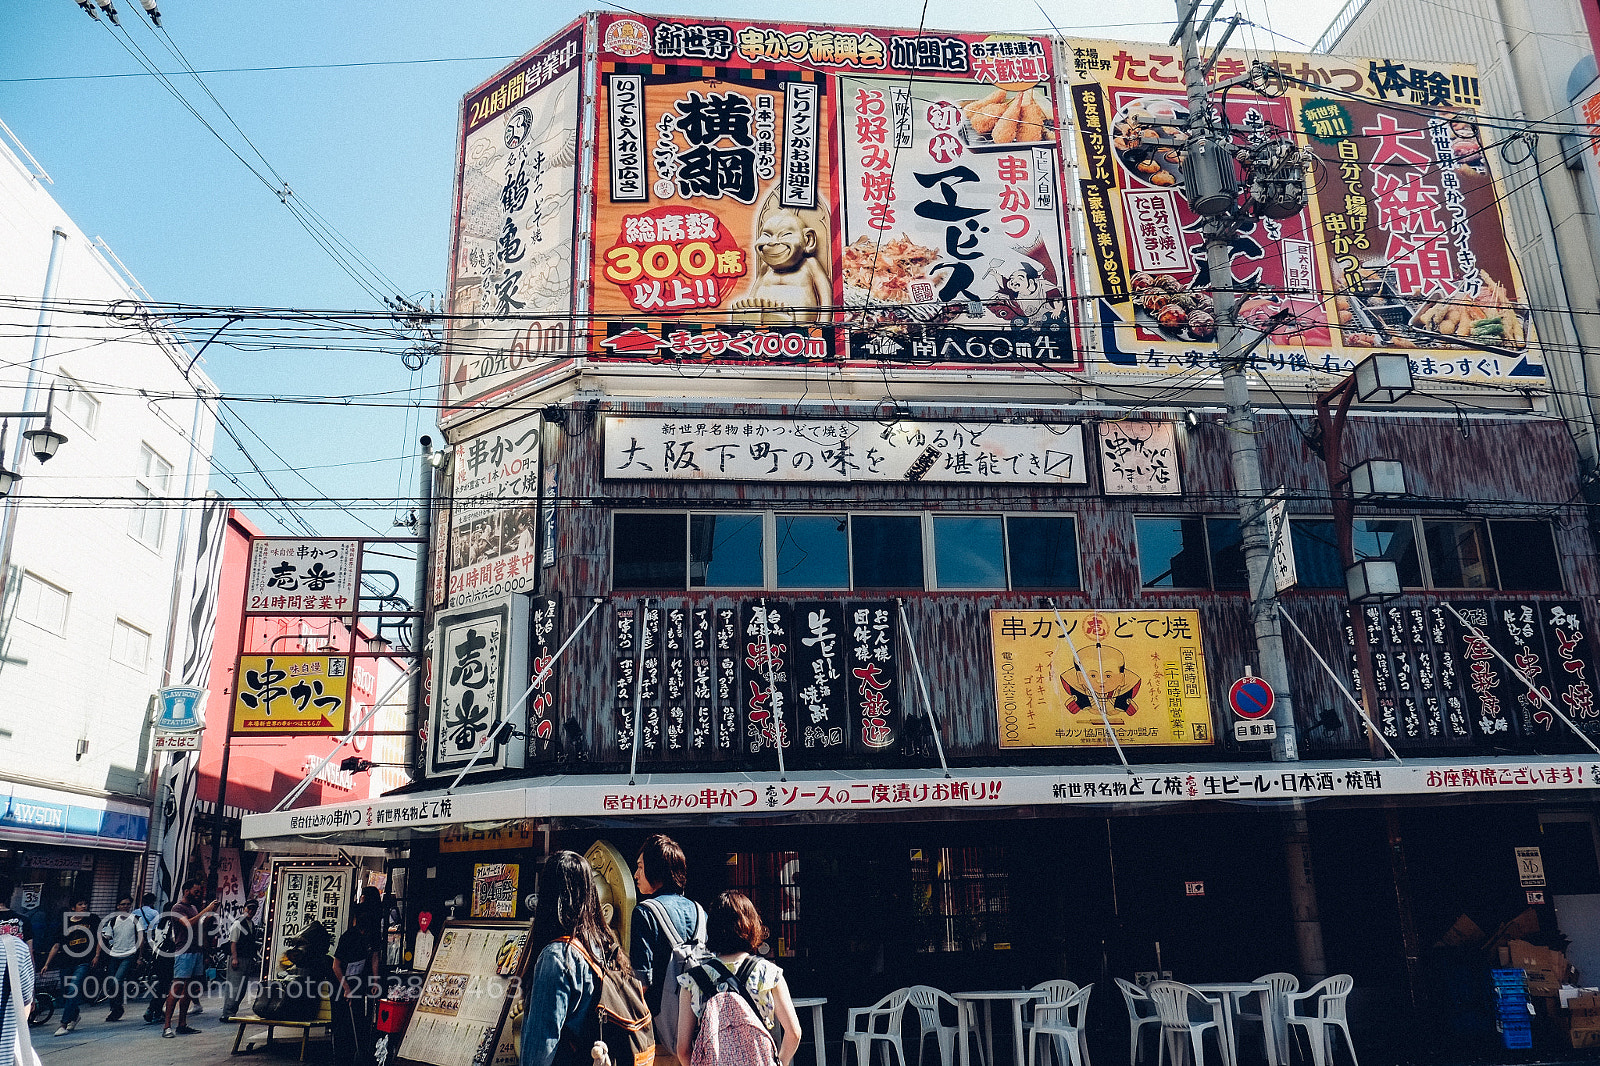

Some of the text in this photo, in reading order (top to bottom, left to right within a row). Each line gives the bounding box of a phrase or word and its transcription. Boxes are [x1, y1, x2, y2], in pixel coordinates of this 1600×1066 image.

[655, 23, 733, 59] 新世界
[738, 28, 886, 67] 串かつ振興会
[890, 37, 967, 71] 加盟店
[971, 42, 1043, 57] お子様連れ
[1074, 48, 1098, 59] 本場
[1074, 58, 1111, 70] 新世界
[469, 39, 578, 128] 24時間営業中
[893, 89, 911, 145] 大阪名物
[928, 102, 963, 162] 初代
[1305, 107, 1340, 121] 新世界
[616, 79, 638, 193] いつでも入れる広さ
[655, 114, 676, 181] よこづな
[676, 93, 757, 204] 横綱
[757, 96, 775, 179] 日本一の串かつ
[788, 88, 811, 201] ビリケンがお出迎え
[1082, 91, 1110, 185] お友達、カップル、
[855, 89, 897, 230] お好み焼き
[998, 155, 1030, 239] 串かつ
[1337, 140, 1370, 250] 自分で揚げる
[1362, 113, 1457, 297] 大統領
[1429, 118, 1481, 298] 新世界串かつバイキング
[494, 160, 530, 322] 鶴亀家
[623, 213, 718, 243] 総席数
[913, 166, 991, 301] エビス
[1151, 196, 1178, 262] 自分で焼く
[605, 243, 745, 282] 300席
[633, 279, 716, 308] 以上!!
[669, 329, 827, 358] まっすぐ100m
[912, 336, 1062, 360] 南へ60m先
[661, 422, 848, 438] 新世界名物串かつ・どて焼き
[456, 444, 467, 485] 味自慢
[467, 428, 539, 477] 串かつ
[617, 437, 884, 477] 大阪下町の味を
[1112, 459, 1171, 484] うまい店
[270, 545, 338, 560] 味自慢 串かつ
[450, 551, 534, 594] 24時間営業中
[267, 561, 336, 591] 壱番
[251, 595, 348, 610] 24時間営業中
[695, 609, 708, 630] イカ
[1519, 605, 1535, 637] 屋台
[618, 618, 634, 648] 串かつ
[668, 627, 679, 649] もち
[801, 608, 841, 680] 生ビール
[853, 608, 873, 662] 団体様
[872, 609, 892, 662] お一人様
[1001, 615, 1078, 641] 串カツ
[1114, 616, 1193, 640] どて焼
[1504, 609, 1525, 646] 仕込み
[240, 658, 342, 716] 串かつ
[289, 662, 322, 674] 味自慢
[694, 666, 710, 699] どて焼
[812, 658, 832, 697] 日本酒
[1035, 663, 1047, 705] オオキニ
[1182, 648, 1198, 696] 営業時間
[1556, 628, 1600, 719] どて焼
[164, 691, 199, 700] LAWSON
[446, 629, 489, 750] 壱番
[617, 678, 629, 699] キス
[641, 678, 654, 699] チーズ
[799, 684, 830, 724] 焼酎
[852, 662, 895, 748] 大歓迎
[1024, 675, 1037, 730] ゴヒイキニ
[1165, 662, 1186, 740] 二十四時間営業中
[1514, 645, 1554, 732] 串かつ
[161, 718, 195, 727] STATION
[698, 706, 710, 735] にんにく
[1237, 722, 1276, 737] 自動車
[603, 788, 758, 811] 屋台仕込みの串かつ
[1052, 776, 1183, 799] 新世界名物どて焼
[4, 803, 63, 827] LAWSON
[290, 809, 362, 829] 屋台仕込みの串かつ
[376, 799, 453, 824] 新世界名物どて焼
[288, 892, 299, 909] 店内
